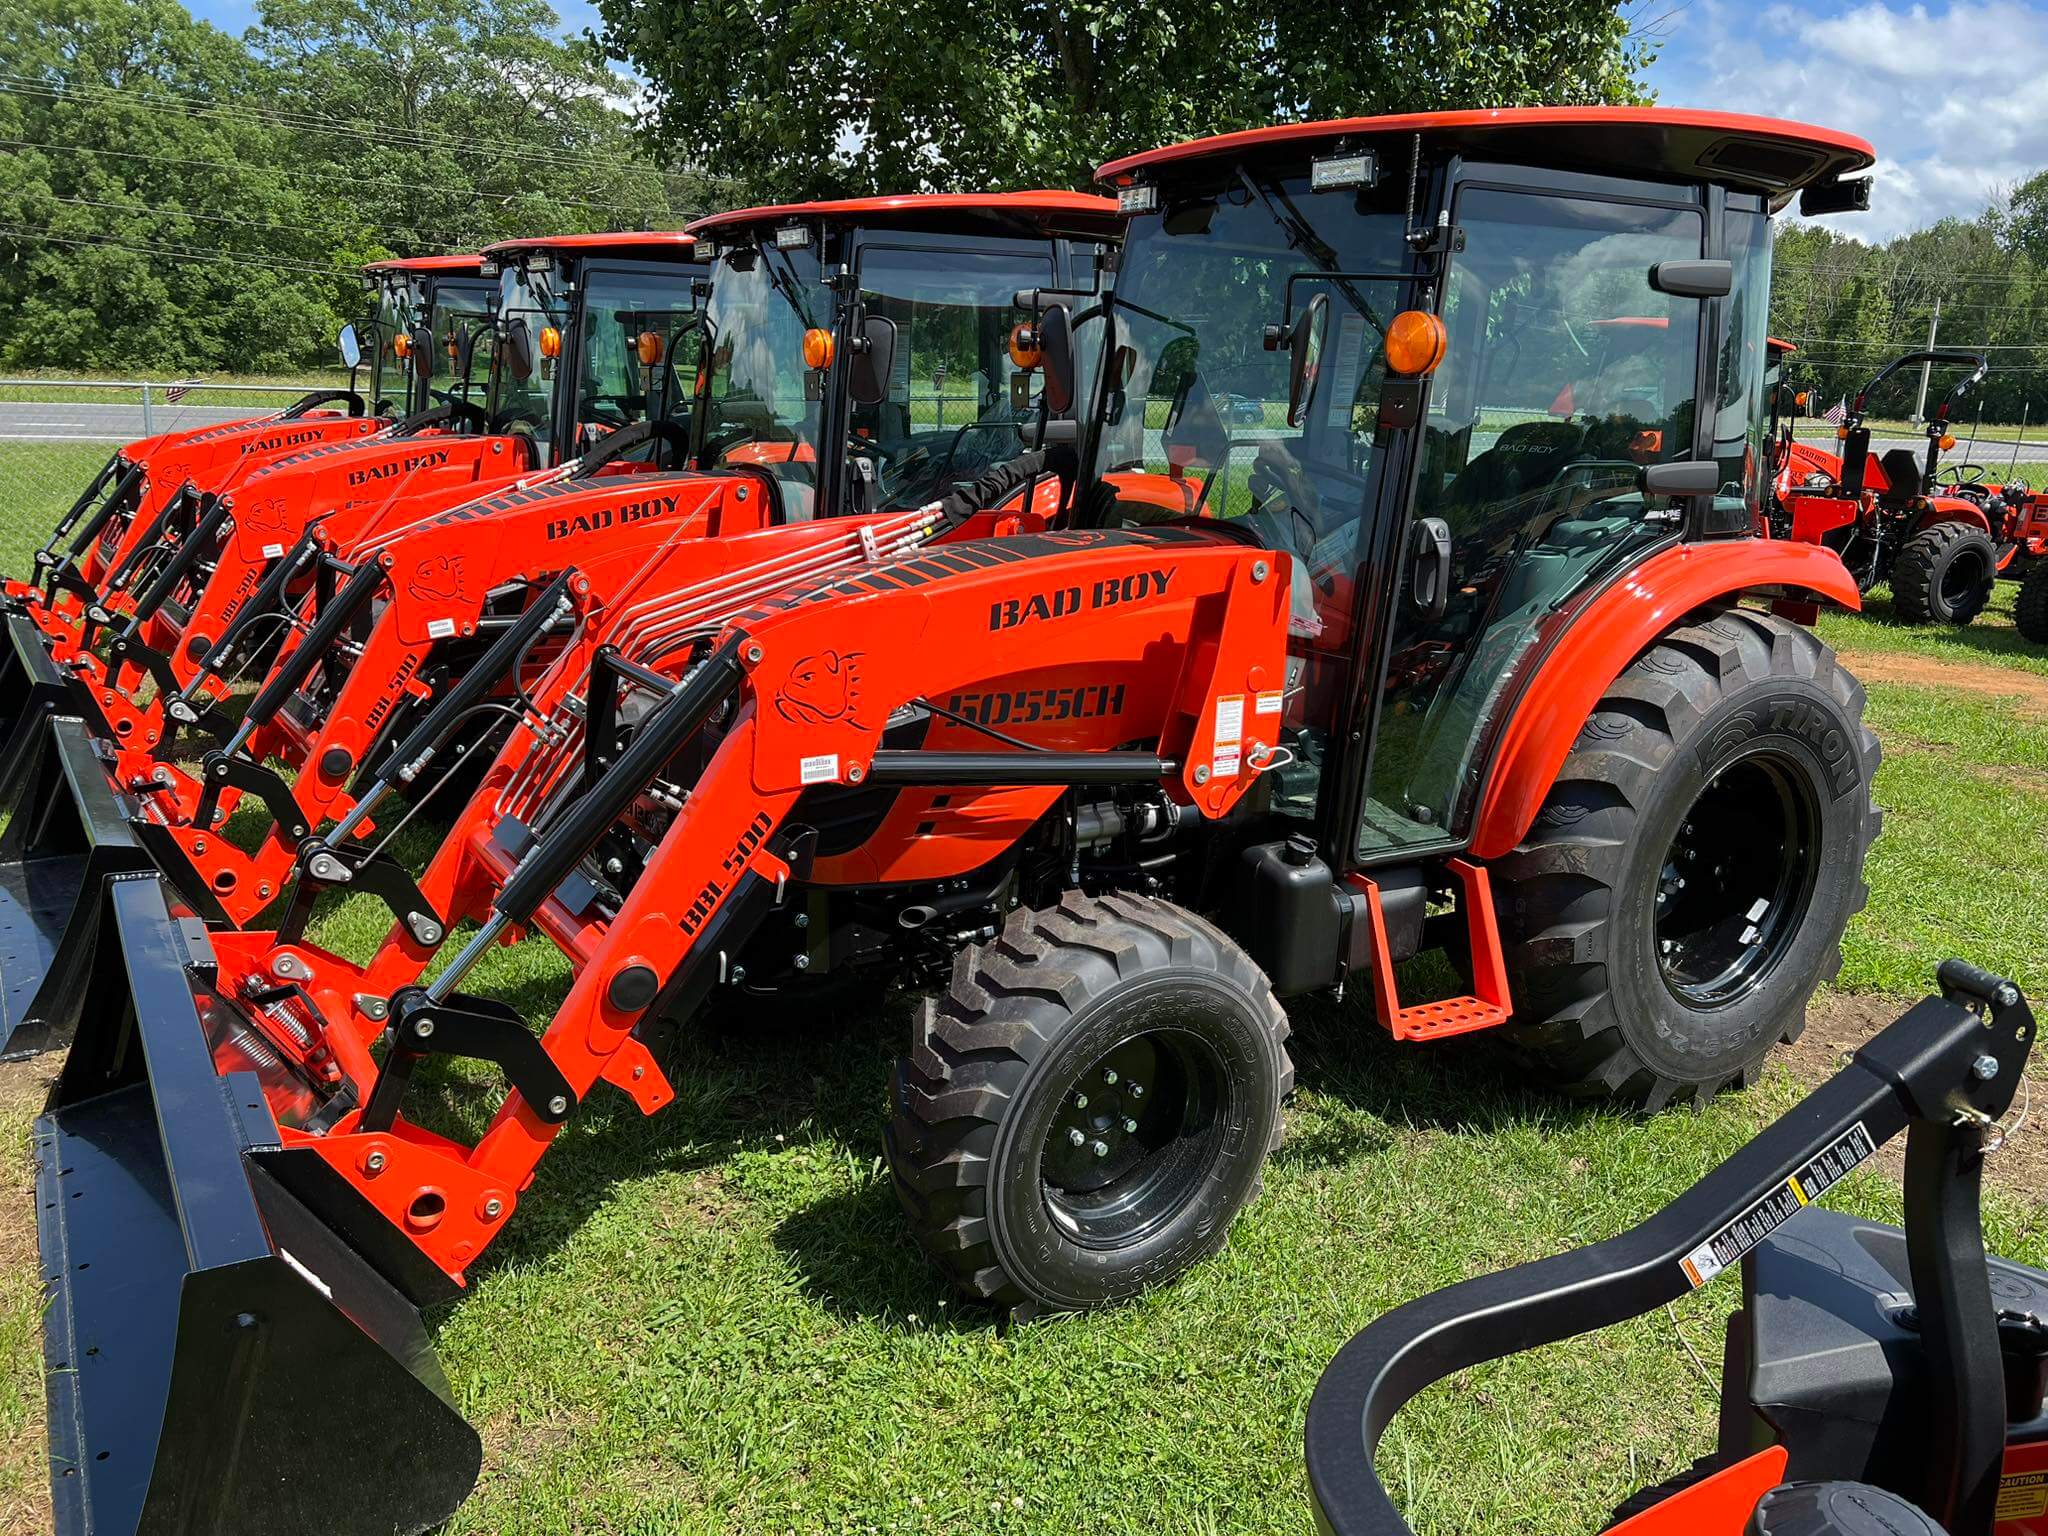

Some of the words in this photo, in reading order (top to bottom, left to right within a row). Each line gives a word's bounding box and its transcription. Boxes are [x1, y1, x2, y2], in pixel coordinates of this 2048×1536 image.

[241, 435, 282, 454] BAD
[287, 429, 325, 446] BOY
[1499, 443, 1527, 453] BAD
[1528, 445, 1559, 455] BOY
[348, 463, 399, 486] BAD
[405, 450, 449, 473] BOY
[546, 510, 612, 540] BAD
[620, 494, 680, 523] BOY
[220, 599, 239, 624] BBL
[236, 568, 257, 596] 500
[989, 587, 1081, 632] BAD
[1092, 566, 1177, 608] BOY
[364, 695, 392, 730] BBL
[388, 653, 418, 693] 500
[945, 684, 1126, 728] 5055CH
[1768, 700, 1859, 795] TIRON
[678, 880, 728, 936] BBL
[722, 811, 773, 877] 500
